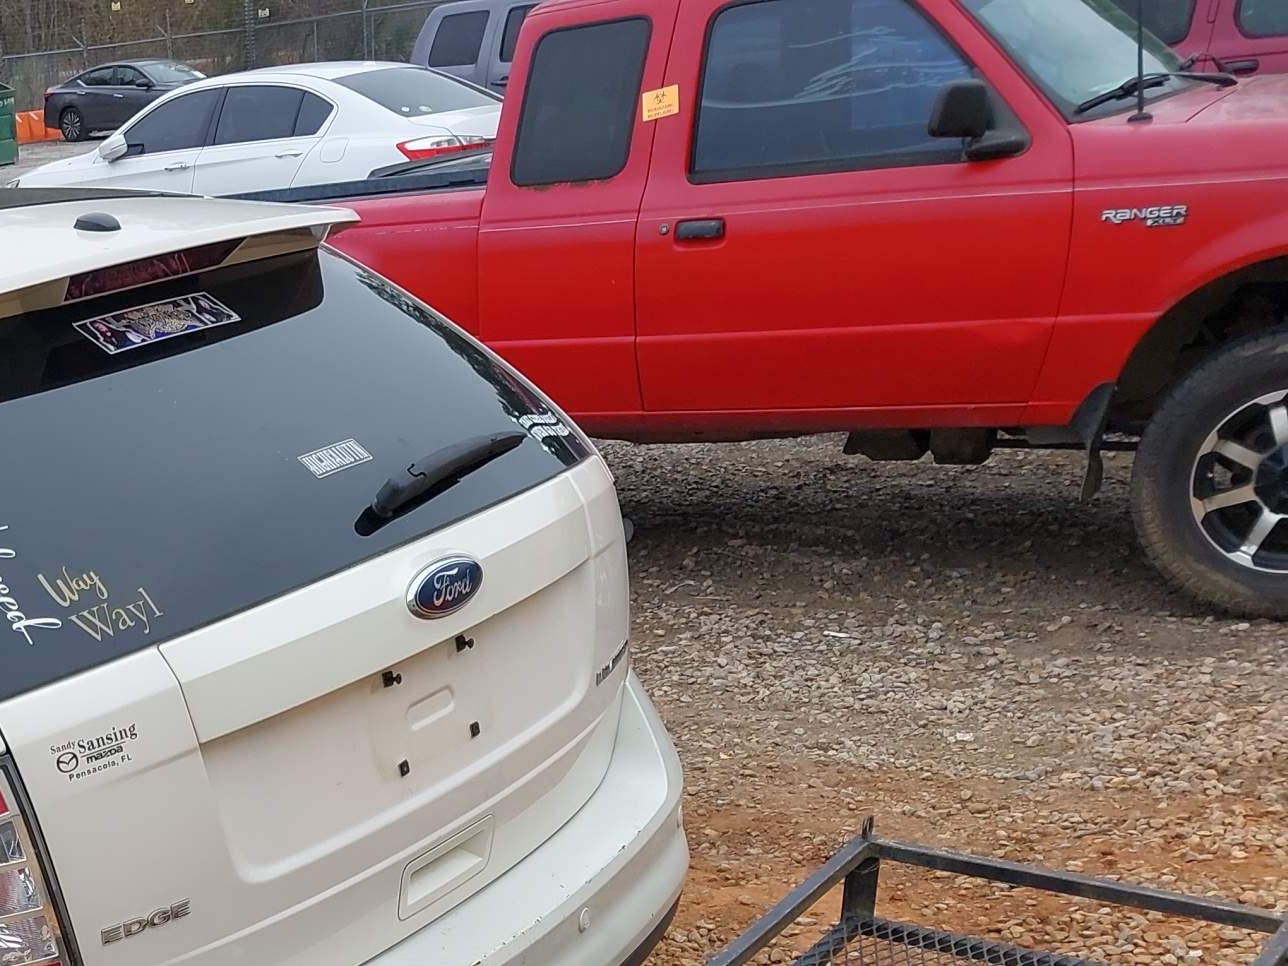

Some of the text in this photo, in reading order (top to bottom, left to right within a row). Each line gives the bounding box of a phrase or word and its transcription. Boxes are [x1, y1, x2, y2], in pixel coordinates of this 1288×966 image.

[1102, 205, 1186, 223] RANGER
[37, 566, 108, 608] Way
[433, 567, 473, 607] Ford
[51, 724, 137, 754] Sandy Sansing
[69, 761, 119, 781] Pensacola,
[100, 897, 192, 946] EDGE
